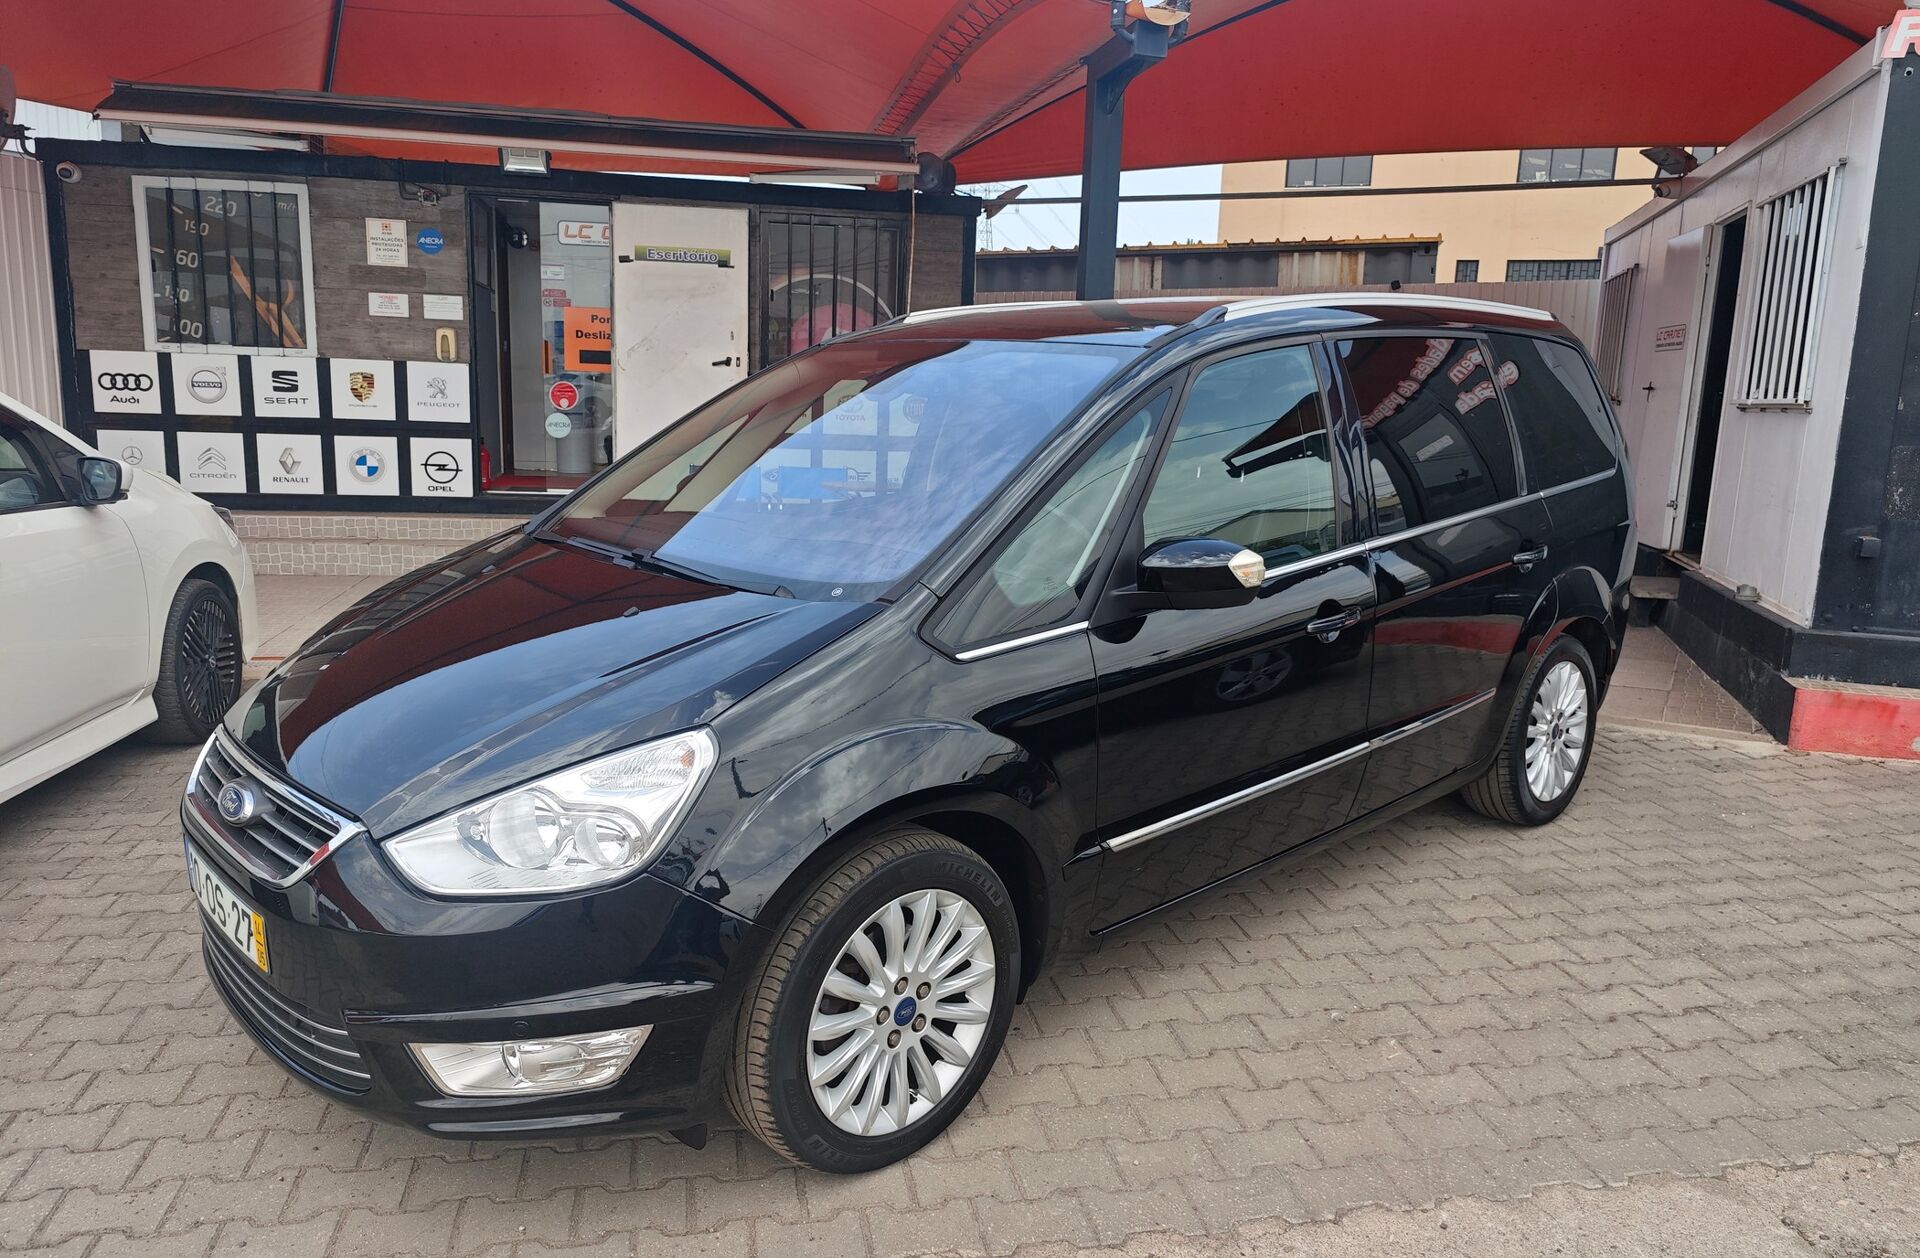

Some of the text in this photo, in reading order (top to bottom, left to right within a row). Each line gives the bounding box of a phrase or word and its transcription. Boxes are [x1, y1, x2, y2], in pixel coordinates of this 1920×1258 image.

[564, 223, 594, 239] LC
[174, 249, 199, 268] 60
[647, 247, 719, 263] Escritório
[164, 285, 190, 303] 10
[575, 329, 611, 341] Desliz
[110, 395, 140, 404] Audi
[264, 396, 309, 405] SEAT
[416, 401, 461, 409] PEUGEOT
[835, 414, 866, 422] TOYOTA
[272, 476, 310, 484] RENAULT
[935, 862, 1004, 907] MICHELIN
